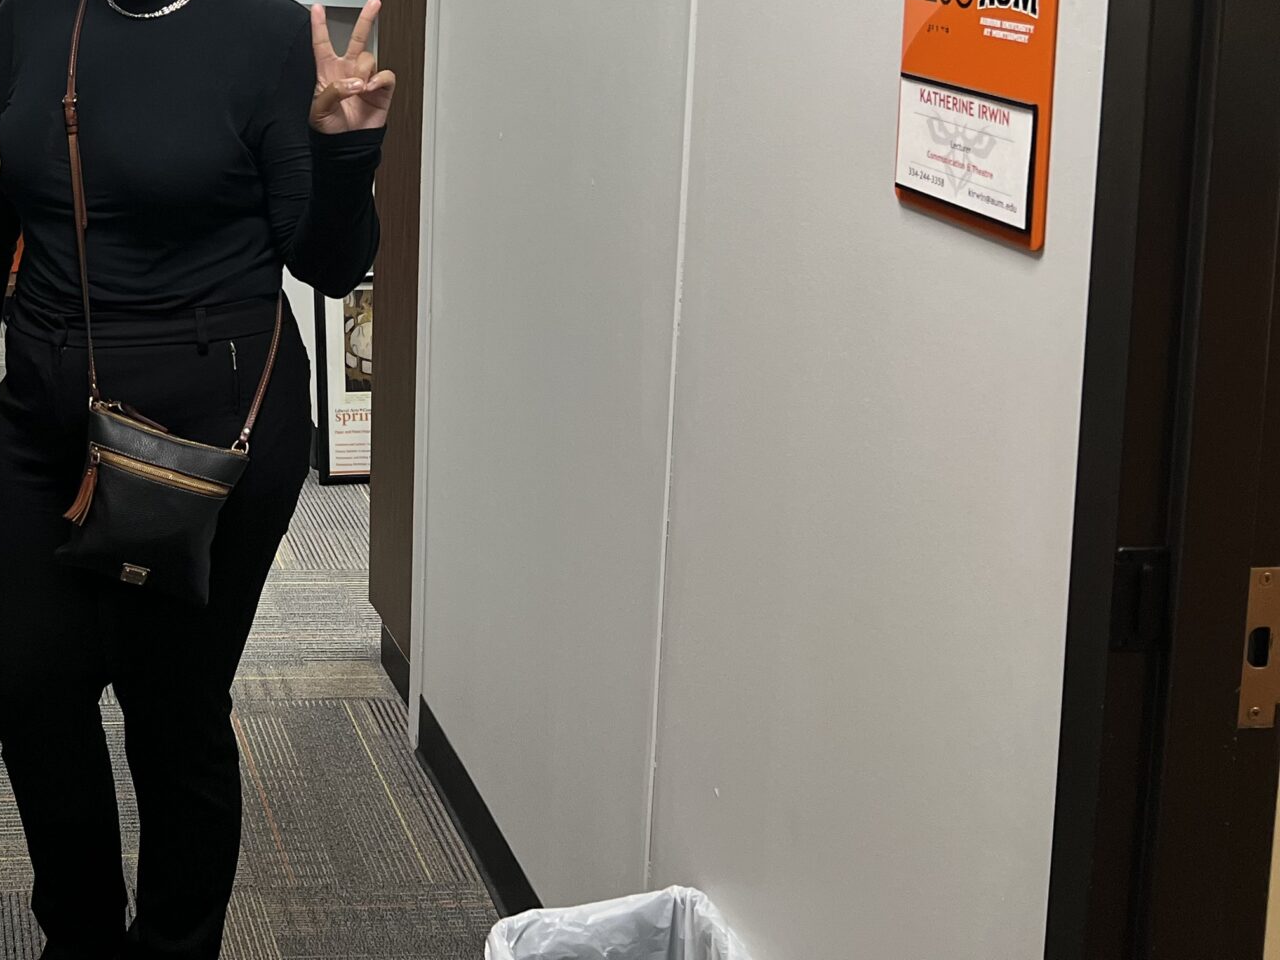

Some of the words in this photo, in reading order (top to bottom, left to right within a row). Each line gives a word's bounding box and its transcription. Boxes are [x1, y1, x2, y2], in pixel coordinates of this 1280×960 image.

[919, 87, 975, 117] KATHERINE
[977, 103, 1010, 128] IRWIN
[950, 140, 971, 153] Lecturer
[926, 150, 965, 170] Communication
[972, 164, 993, 179] Theatre
[967, 187, 1017, 214] kirwin@aum.edu
